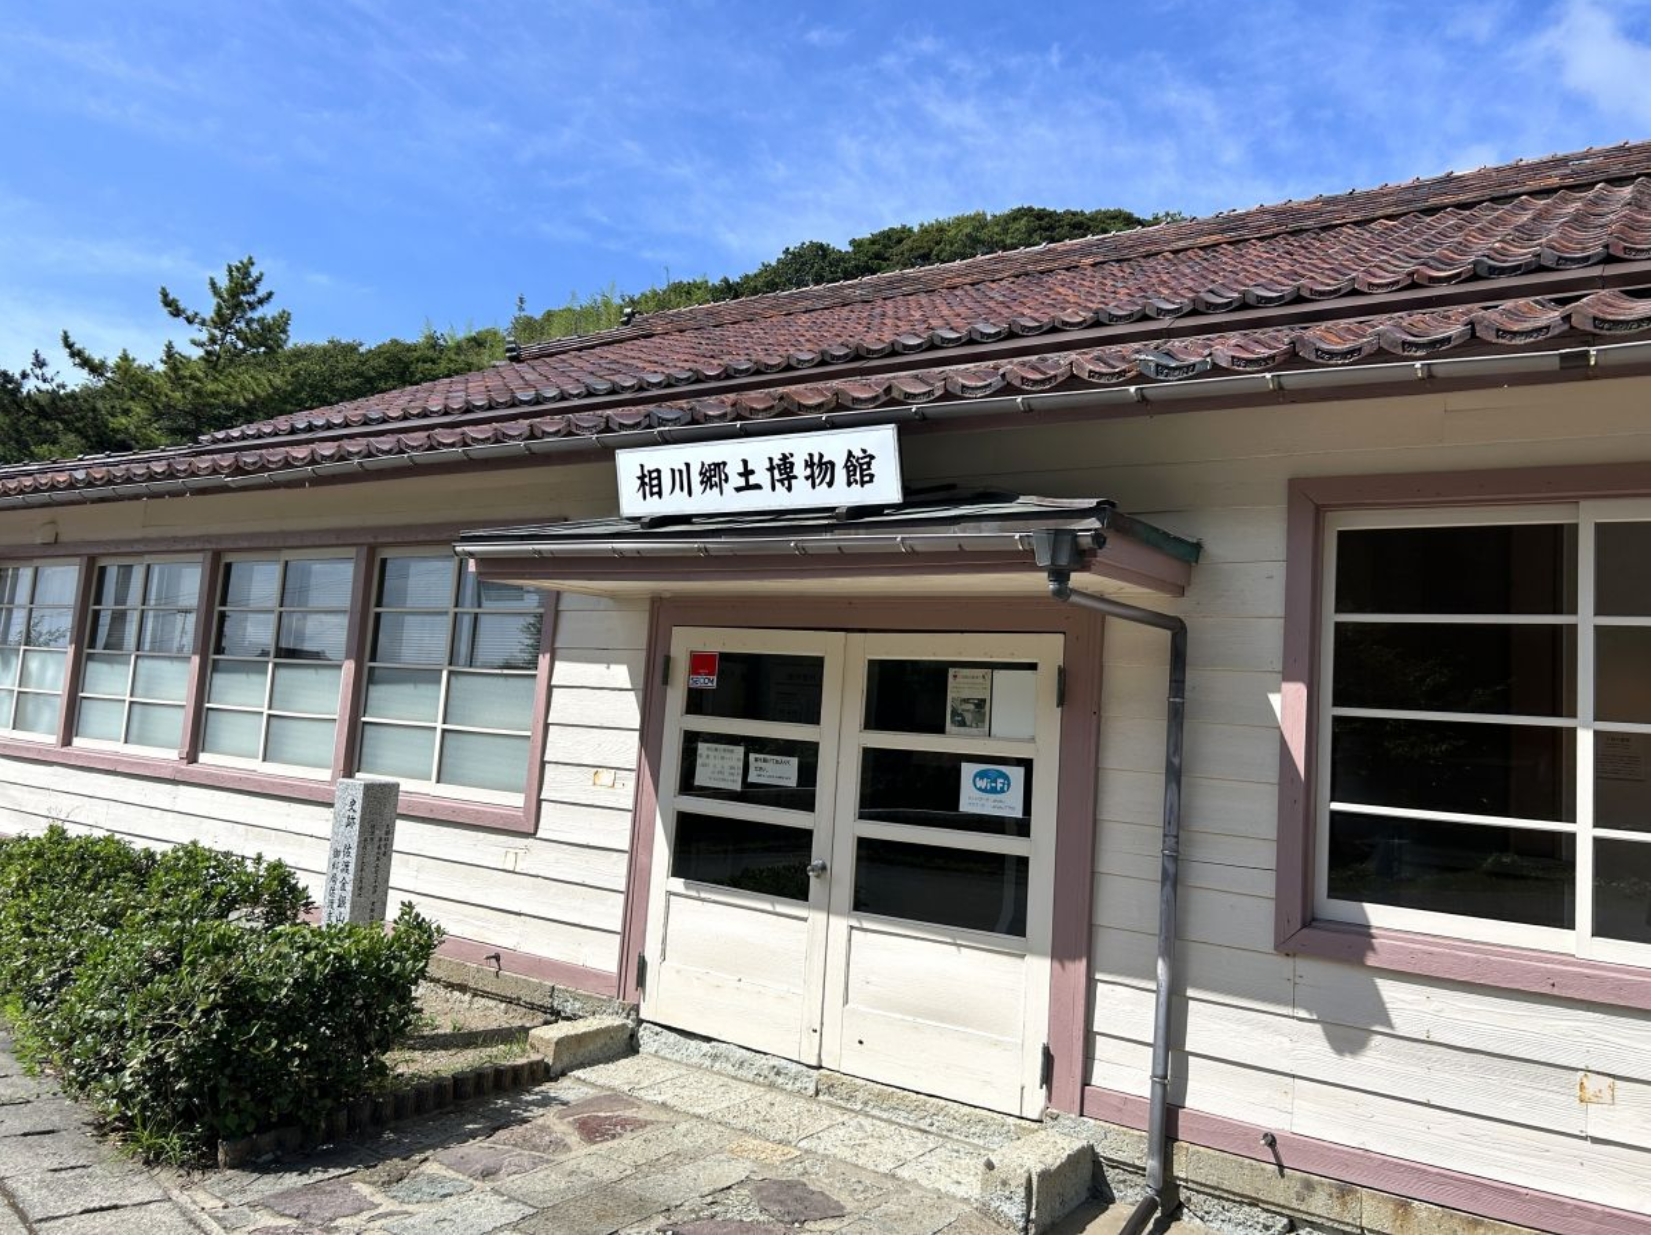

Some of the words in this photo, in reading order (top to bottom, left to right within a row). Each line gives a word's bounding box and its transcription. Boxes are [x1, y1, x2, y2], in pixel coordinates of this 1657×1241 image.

[635, 447, 877, 501] 相川郷土博物館
[975, 777, 1008, 791] Wi-Fi
